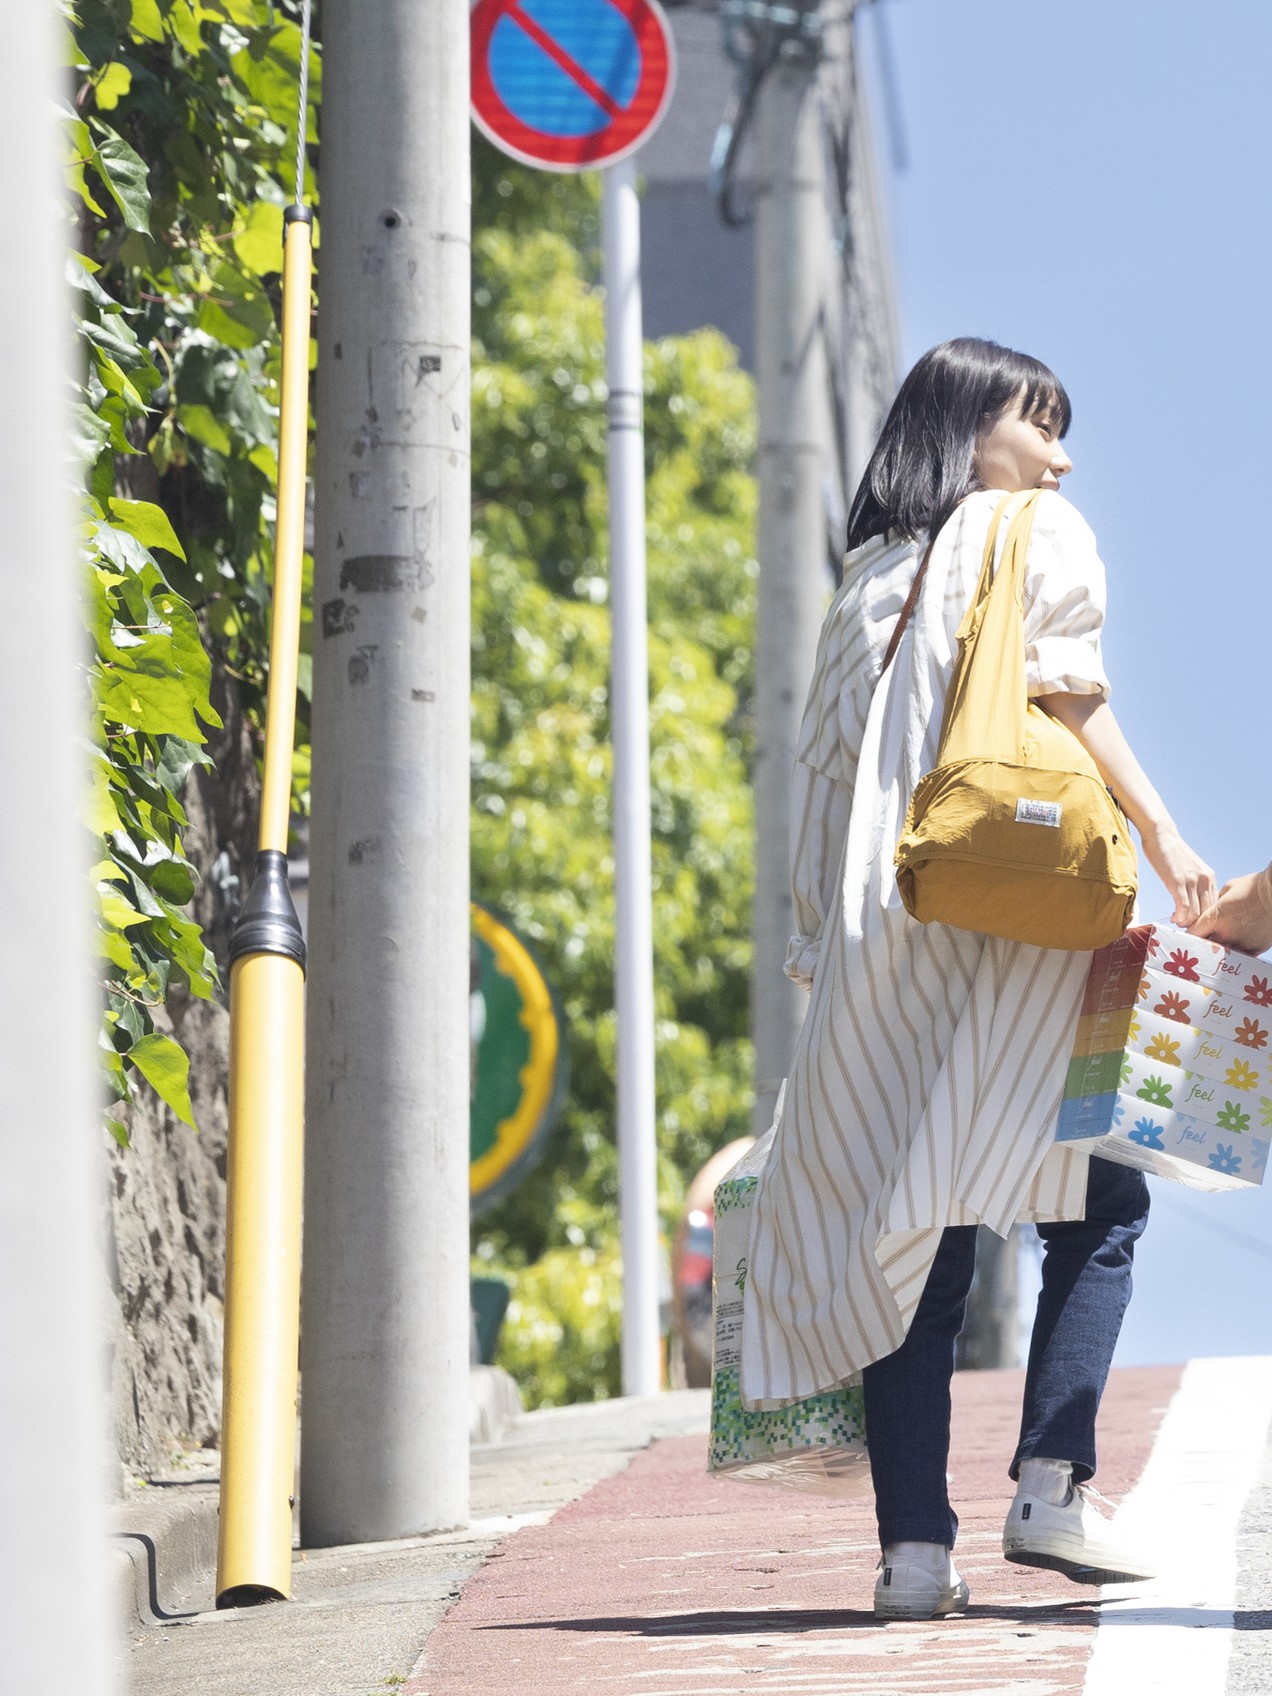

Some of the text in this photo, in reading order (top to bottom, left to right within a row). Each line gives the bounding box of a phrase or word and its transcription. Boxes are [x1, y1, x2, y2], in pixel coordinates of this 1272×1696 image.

[1212, 958, 1241, 976] feel
[1203, 1000, 1233, 1018] feel
[1193, 1041, 1223, 1060] feel
[1185, 1084, 1215, 1102] feel
[1176, 1126, 1207, 1144] feel
